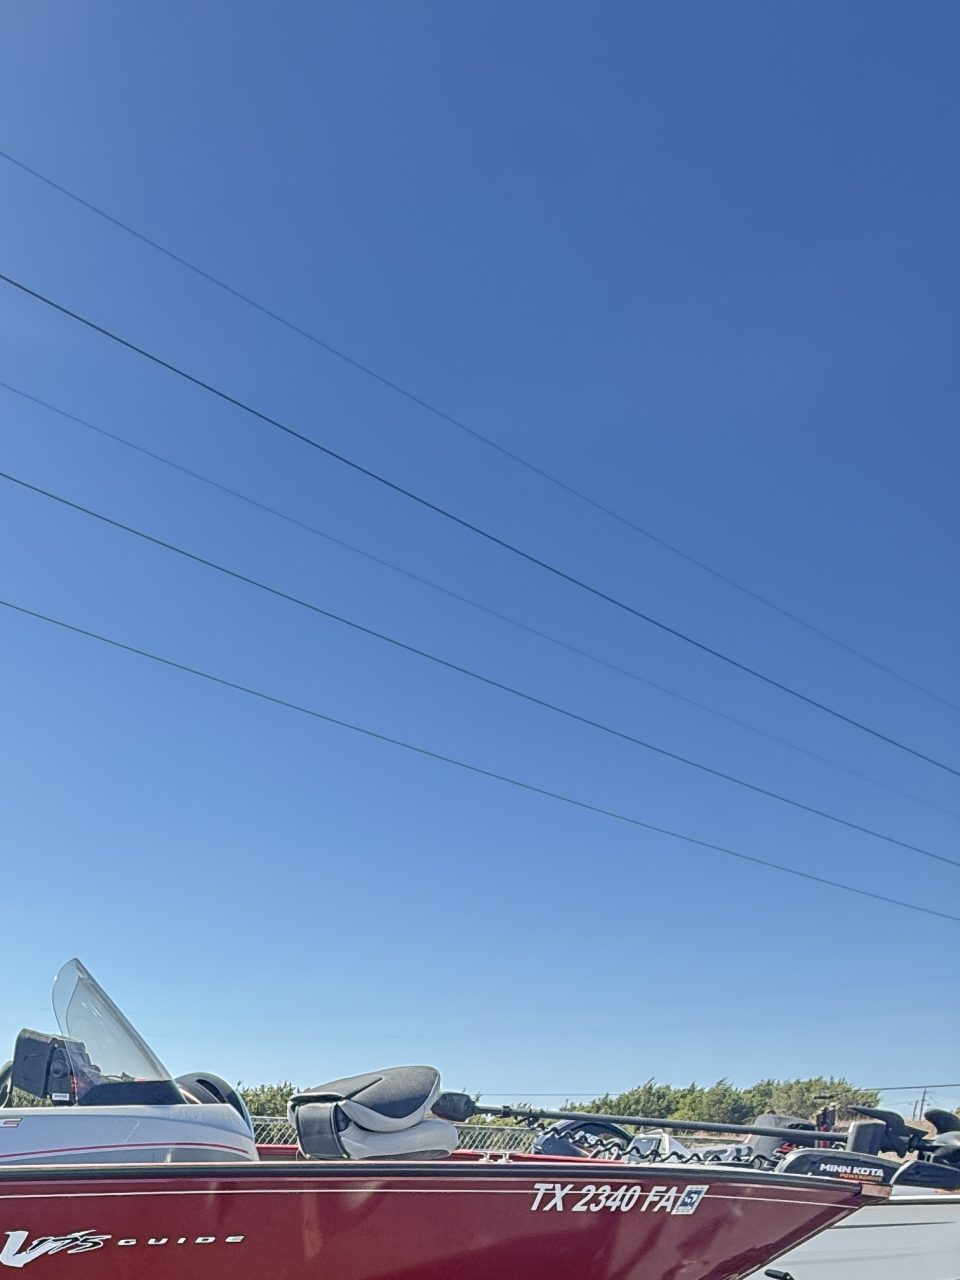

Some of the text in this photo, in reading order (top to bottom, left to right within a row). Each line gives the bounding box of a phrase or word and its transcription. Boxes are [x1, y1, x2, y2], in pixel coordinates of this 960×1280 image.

[820, 1163, 884, 1177] MINN KOTA
[530, 1183, 678, 1213] TX 2340 FA
[117, 1235, 245, 1247] GUIDE
